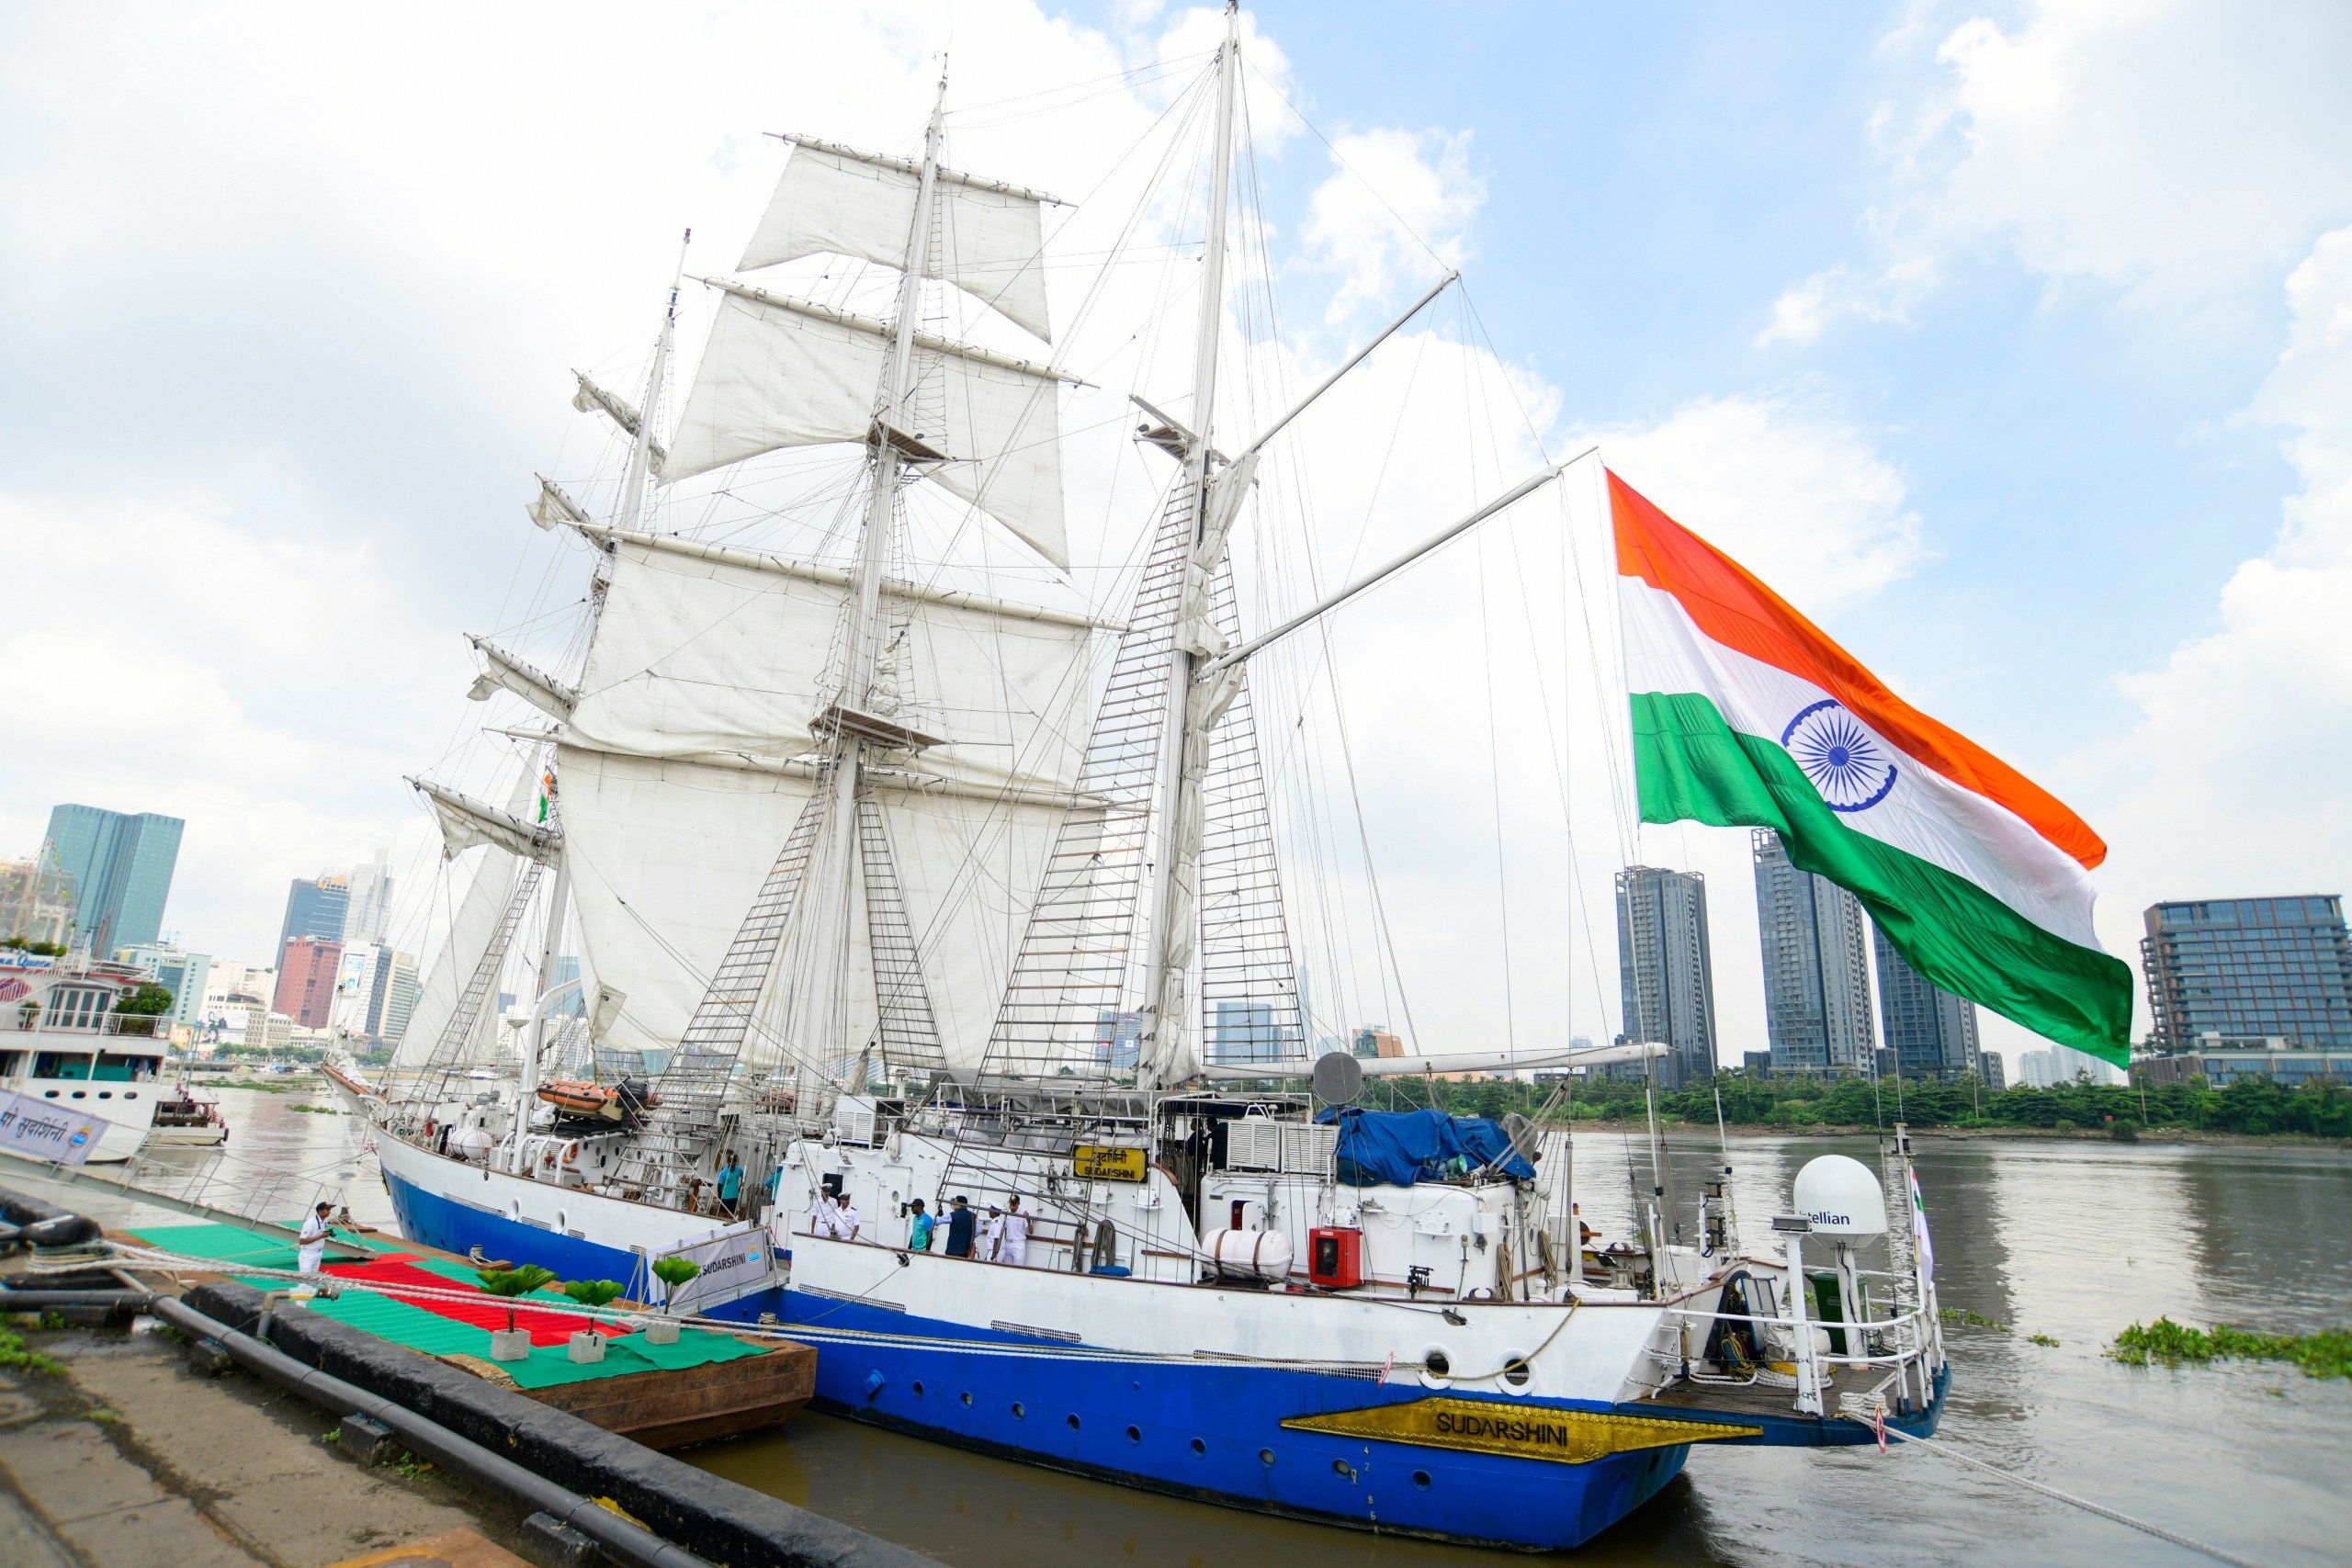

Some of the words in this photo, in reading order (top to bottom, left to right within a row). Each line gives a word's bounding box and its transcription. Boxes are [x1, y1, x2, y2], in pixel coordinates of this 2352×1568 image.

[1799, 1210, 1850, 1225] tellian
[702, 1252, 746, 1276] SUDARSHINI
[1436, 1412, 1567, 1447] SUDARSHINI
